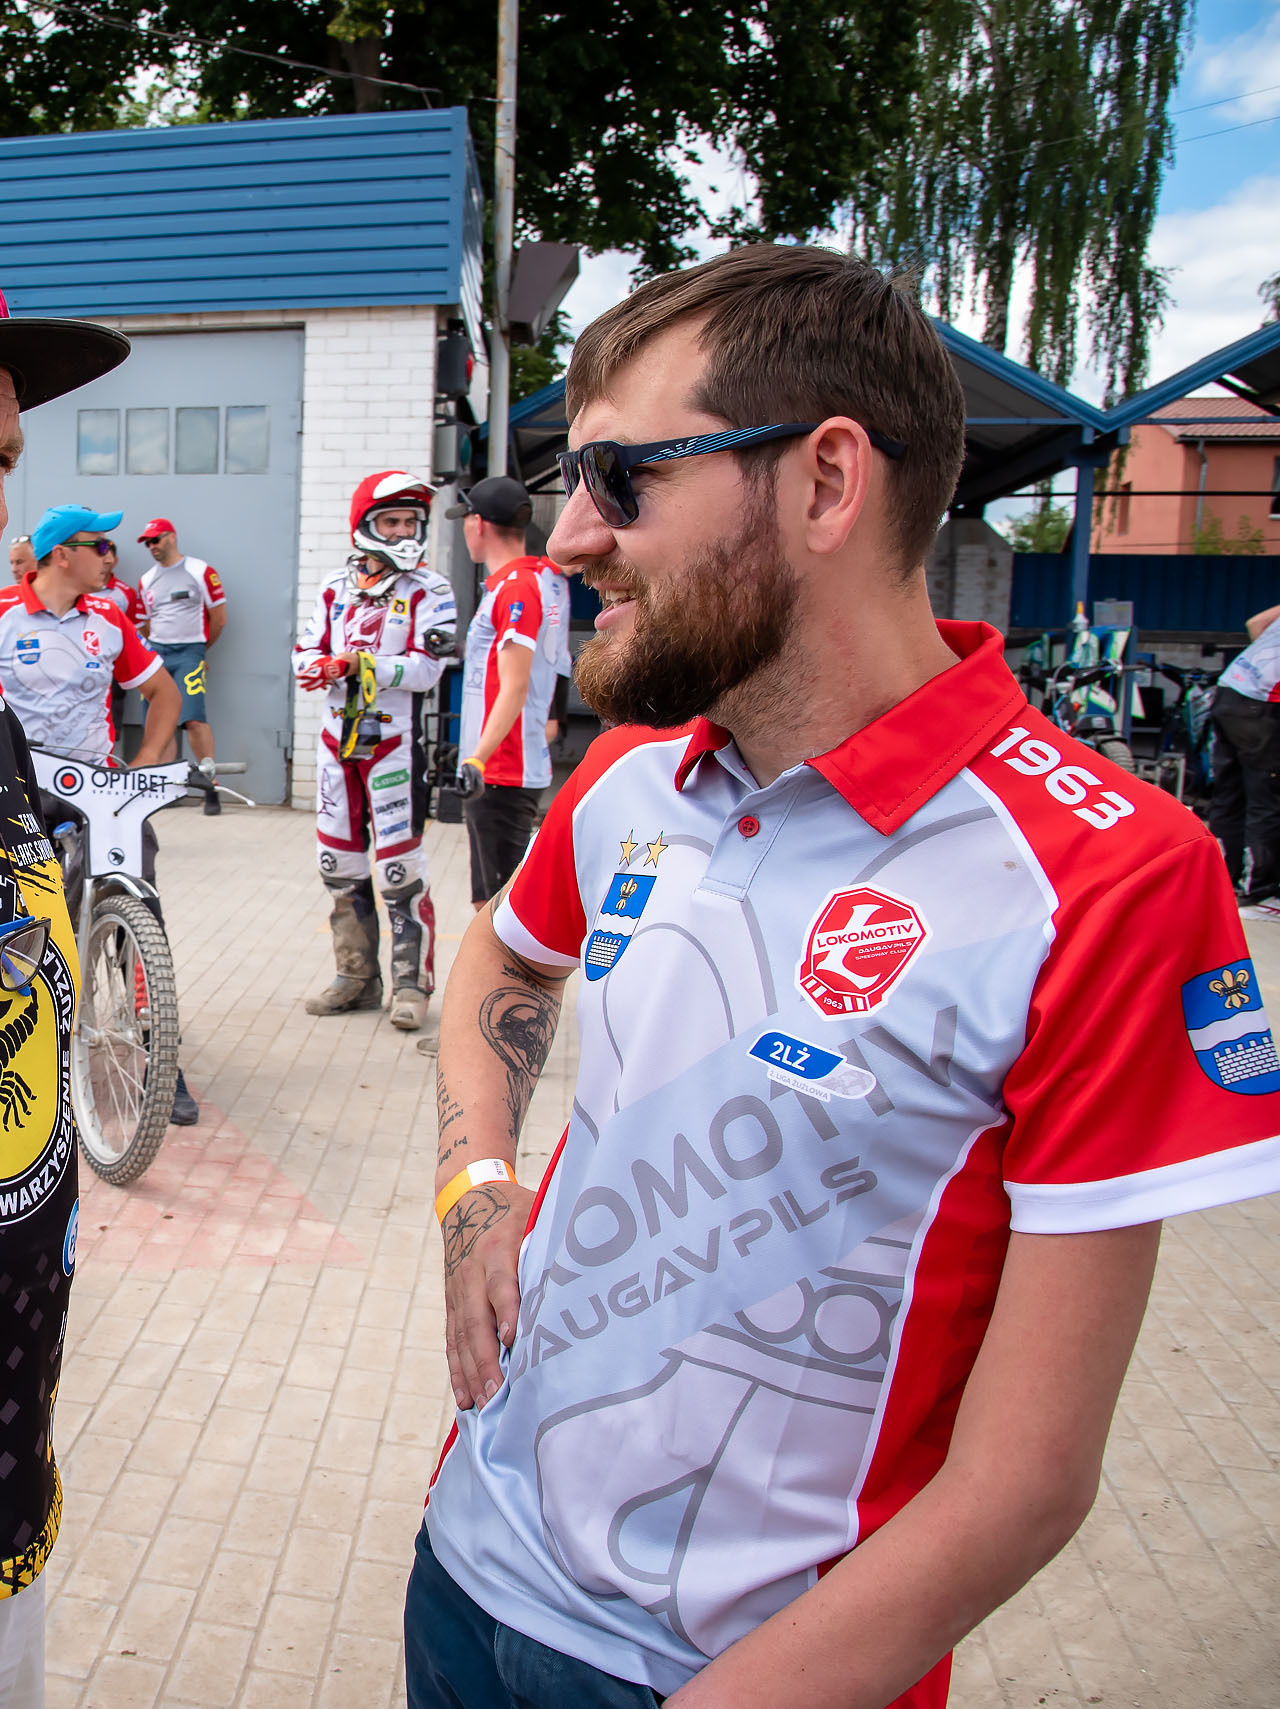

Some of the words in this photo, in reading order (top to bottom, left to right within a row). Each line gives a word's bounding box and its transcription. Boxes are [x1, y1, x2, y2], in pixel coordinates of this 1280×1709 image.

[91, 770, 167, 793] OPTIBET
[989, 726, 1136, 830] 1963
[817, 922, 914, 949] LOKOMOTIV
[858, 941, 913, 955] DAUGAVPILS
[854, 951, 888, 961] SPEEDWAY
[889, 948, 907, 956] CLUB
[823, 996, 843, 1010] 1963
[769, 1040, 811, 1072] 2LŻ
[776, 1073, 791, 1086] LIGA
[791, 1077, 829, 1100] ŻUŻLOWA
